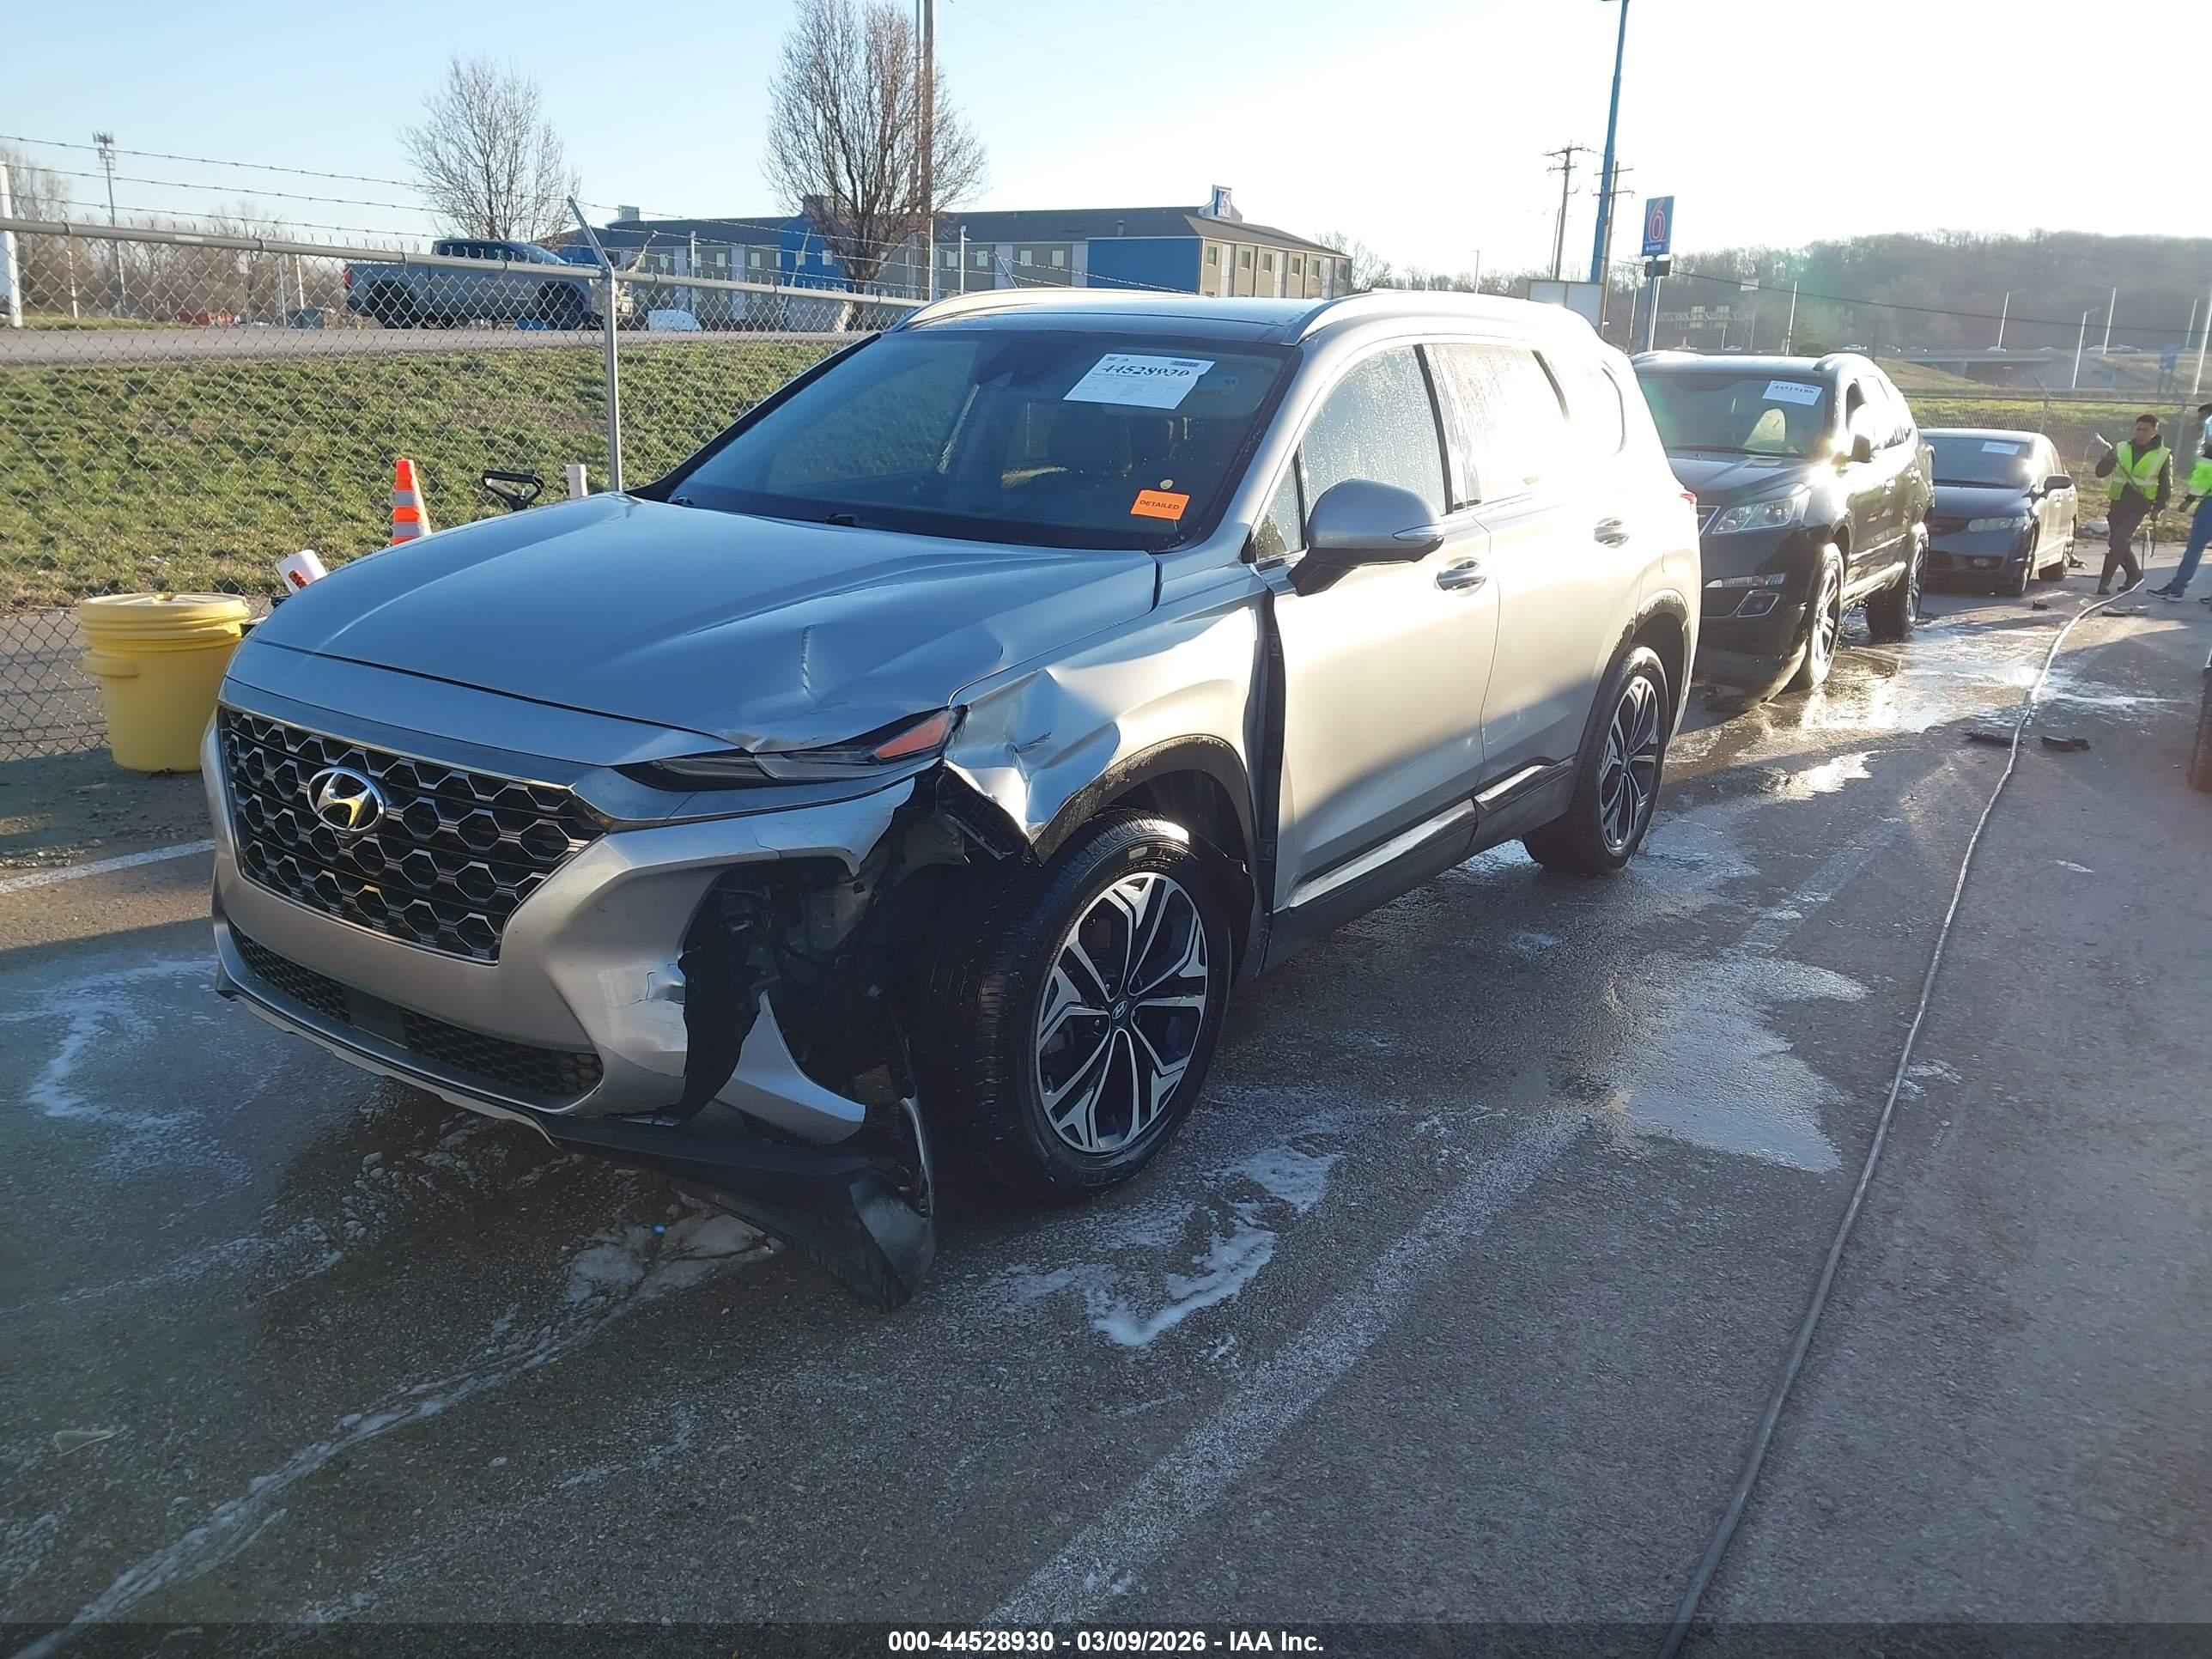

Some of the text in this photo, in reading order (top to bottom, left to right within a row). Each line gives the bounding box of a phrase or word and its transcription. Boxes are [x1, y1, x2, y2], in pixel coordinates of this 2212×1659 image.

[1649, 198, 1666, 242] 6
[1102, 365, 1190, 377] 44528930
[1139, 500, 1180, 510] DETAILED
